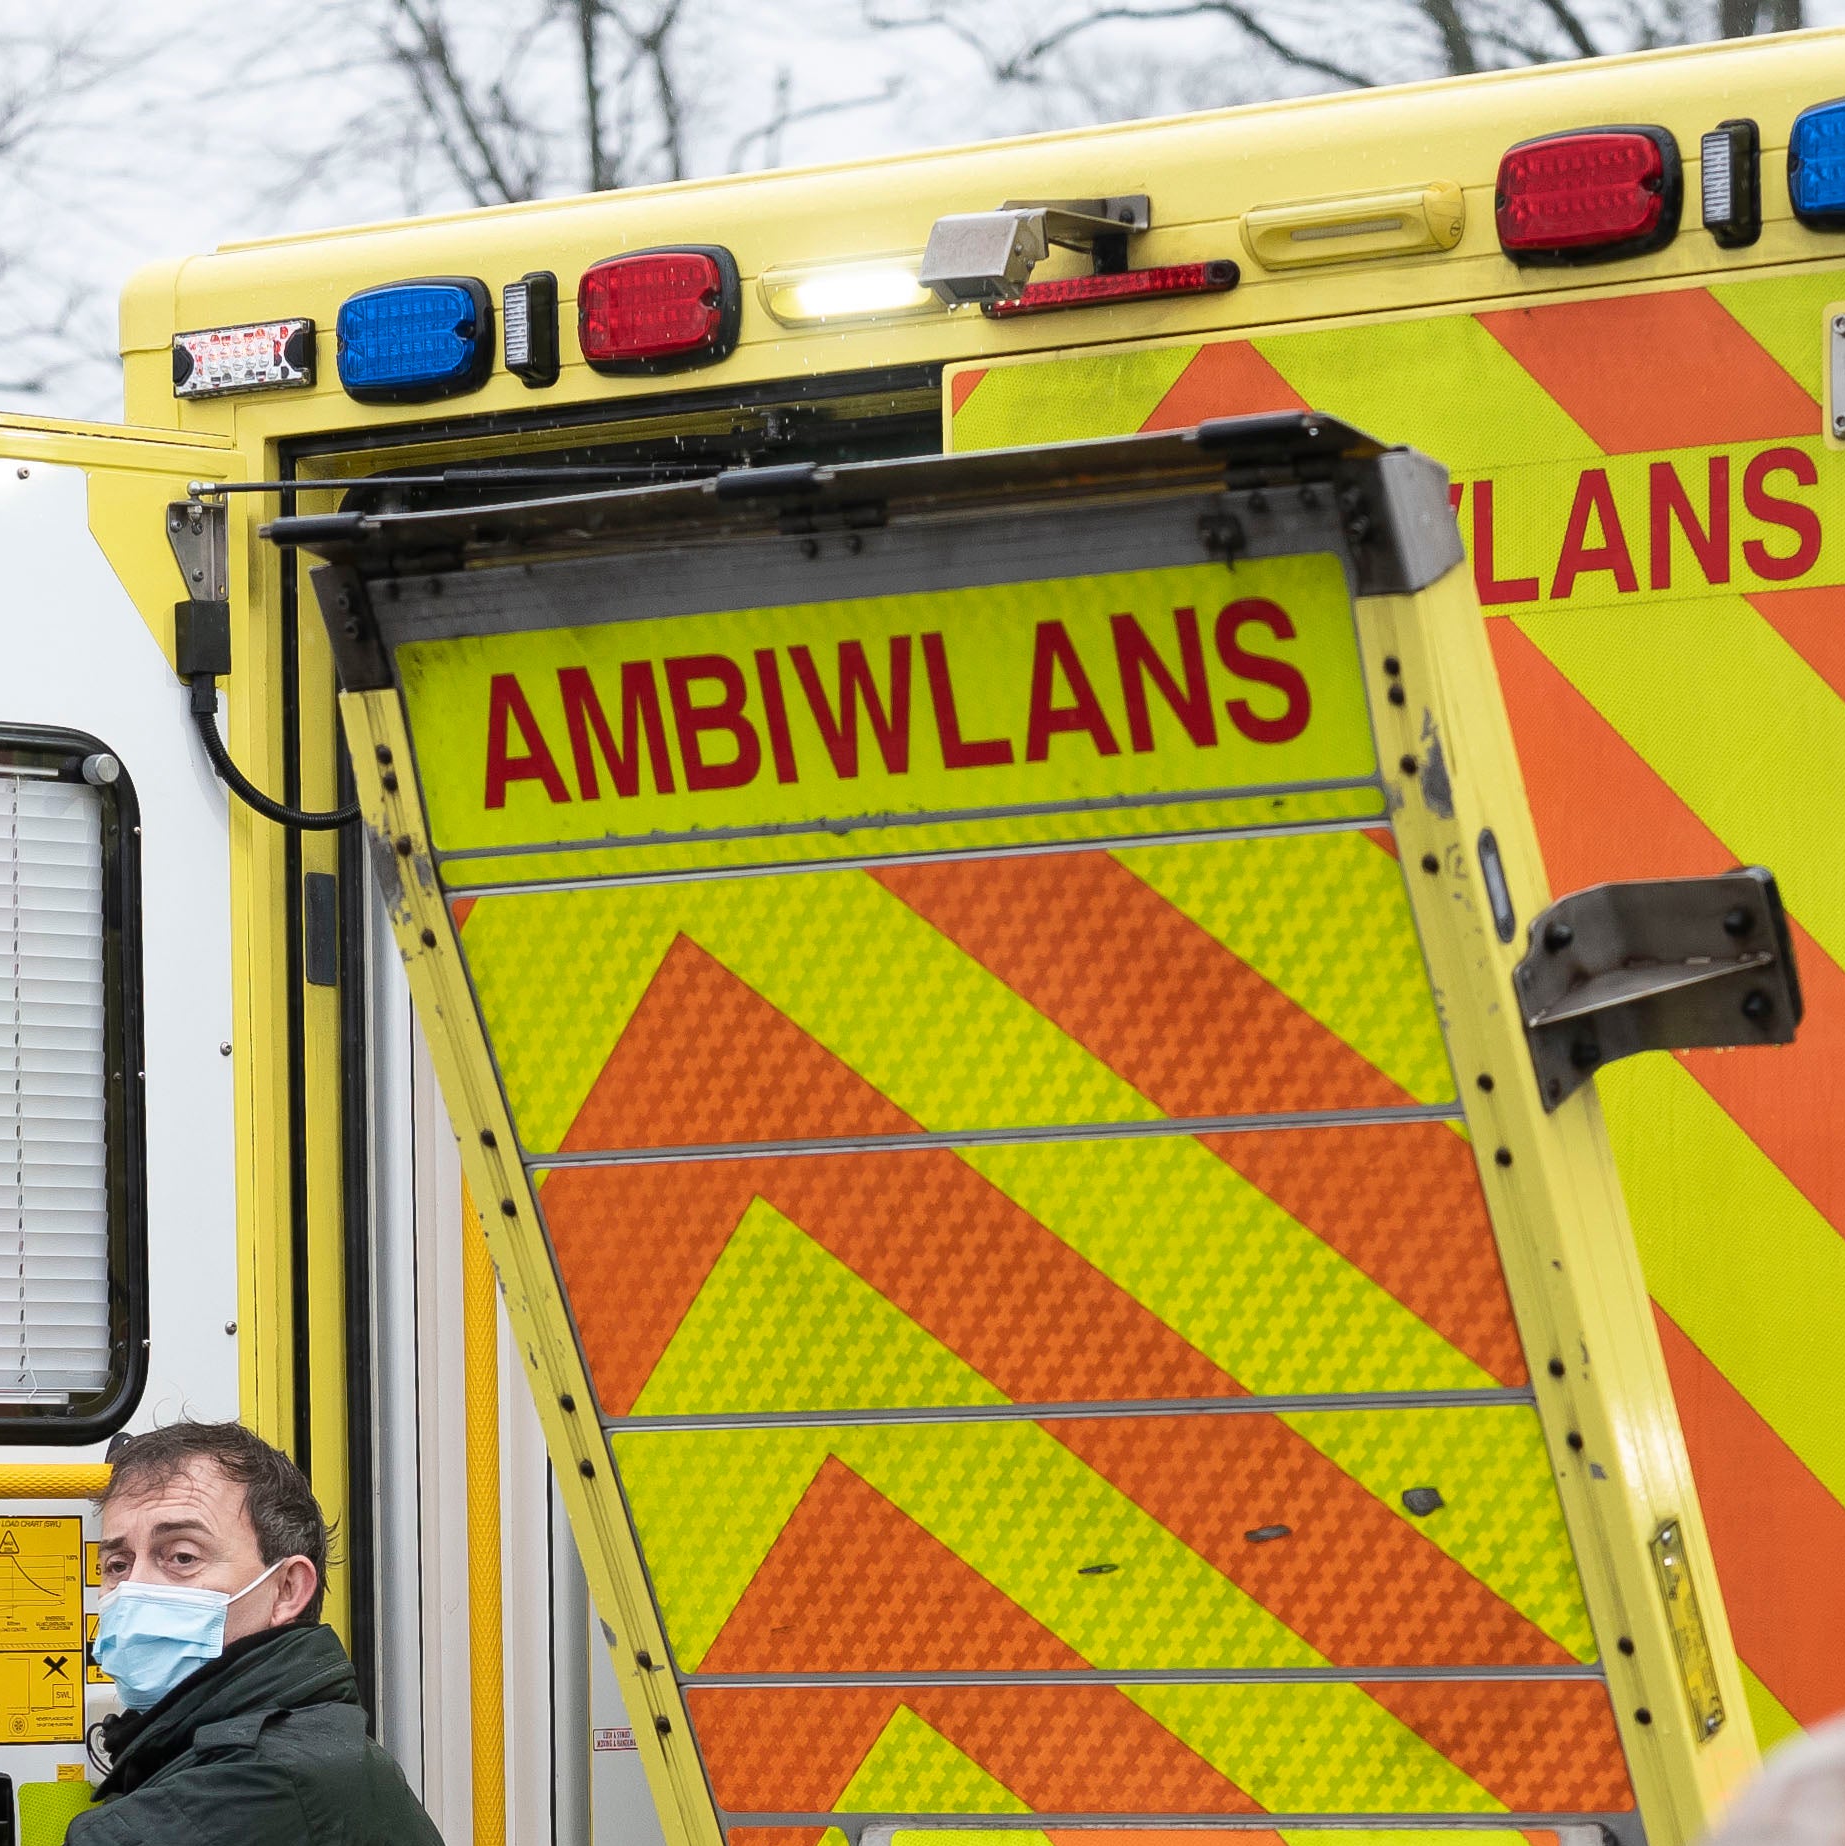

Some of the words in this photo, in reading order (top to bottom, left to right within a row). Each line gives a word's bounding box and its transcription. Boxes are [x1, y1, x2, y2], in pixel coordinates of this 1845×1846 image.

[1448, 446, 1823, 606] LANS
[483, 596, 1313, 810] AMBIWLANS
[1, 1520, 19, 1528] LOAD
[20, 1520, 42, 1528] CHART
[55, 1691, 72, 1699] SWL
